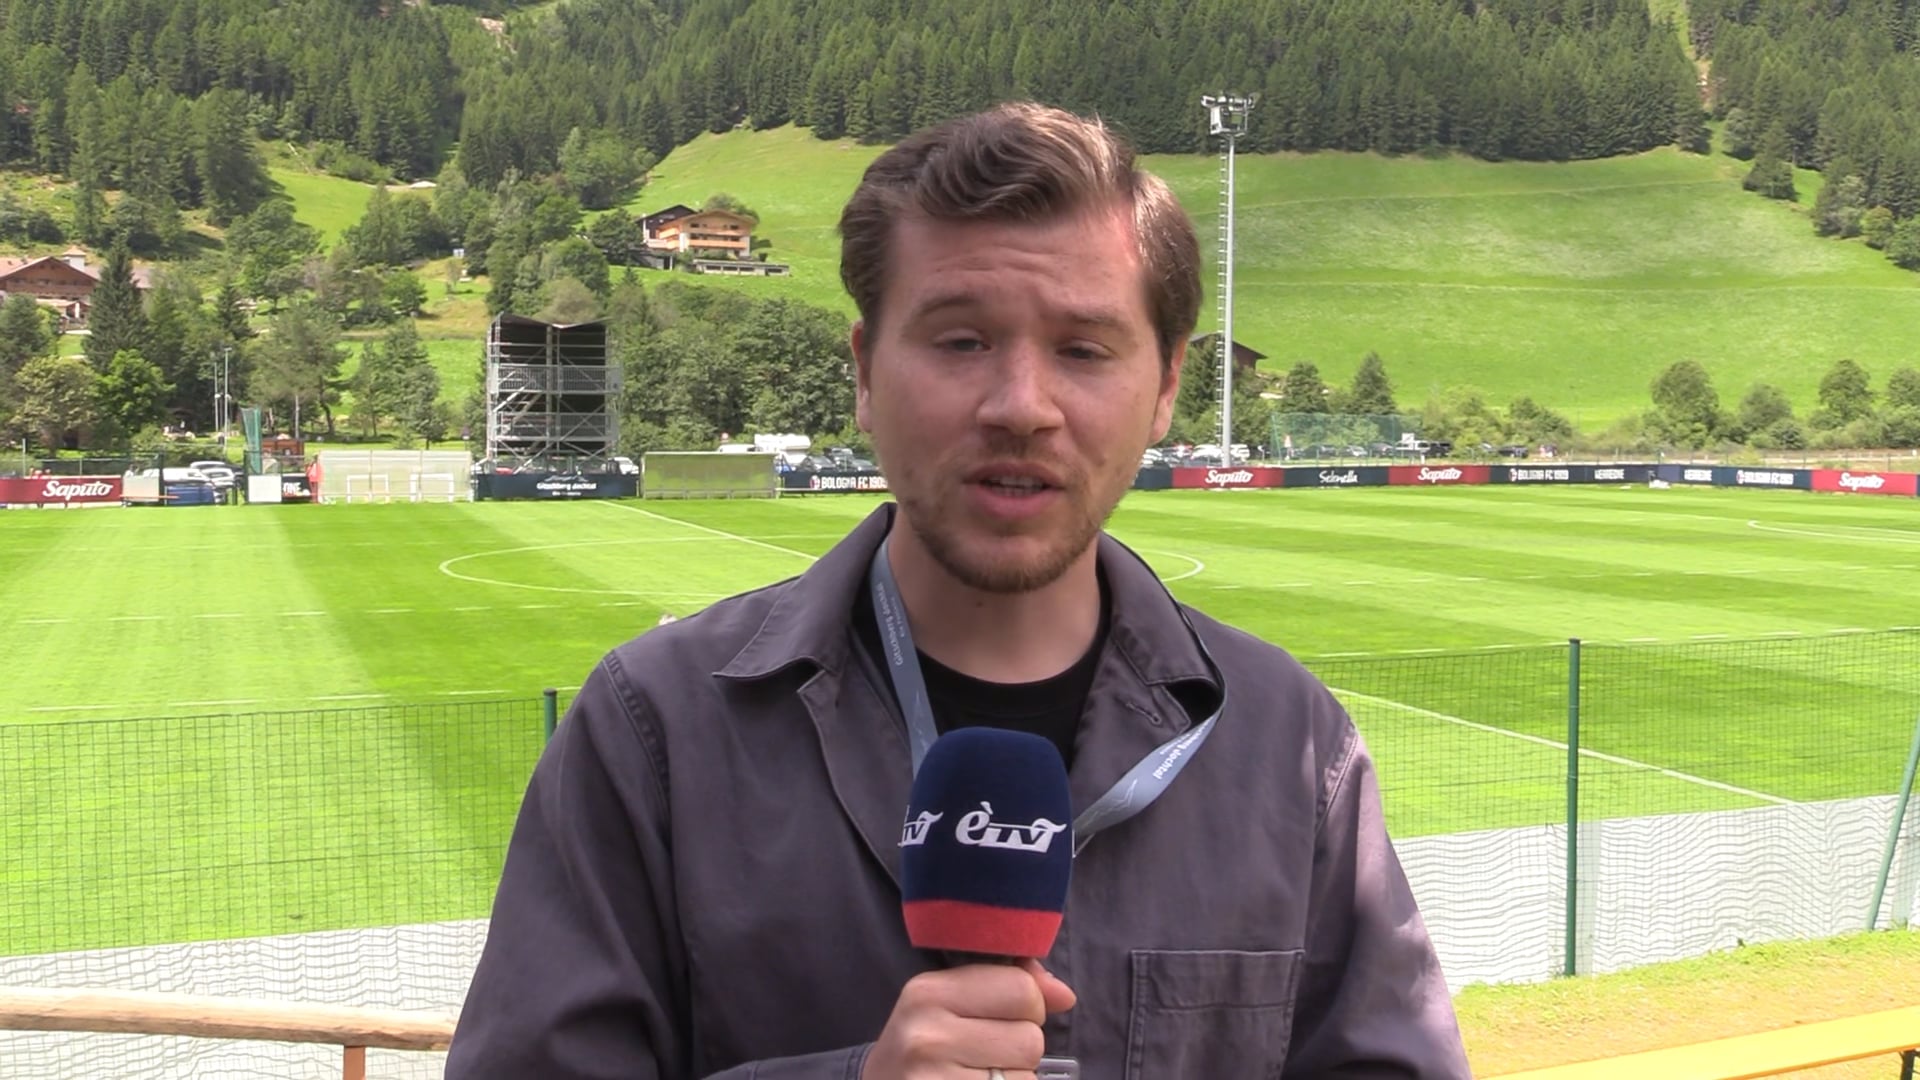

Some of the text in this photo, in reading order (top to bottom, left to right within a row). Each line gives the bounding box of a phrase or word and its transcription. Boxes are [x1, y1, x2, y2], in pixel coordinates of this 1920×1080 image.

[821, 476, 856, 489] BOLOGNA
[858, 476, 868, 489] FC
[1205, 469, 1254, 487] Saputo
[1417, 467, 1462, 484] Saputo
[1838, 472, 1885, 491] Saputo
[42, 480, 114, 501] Saputo
